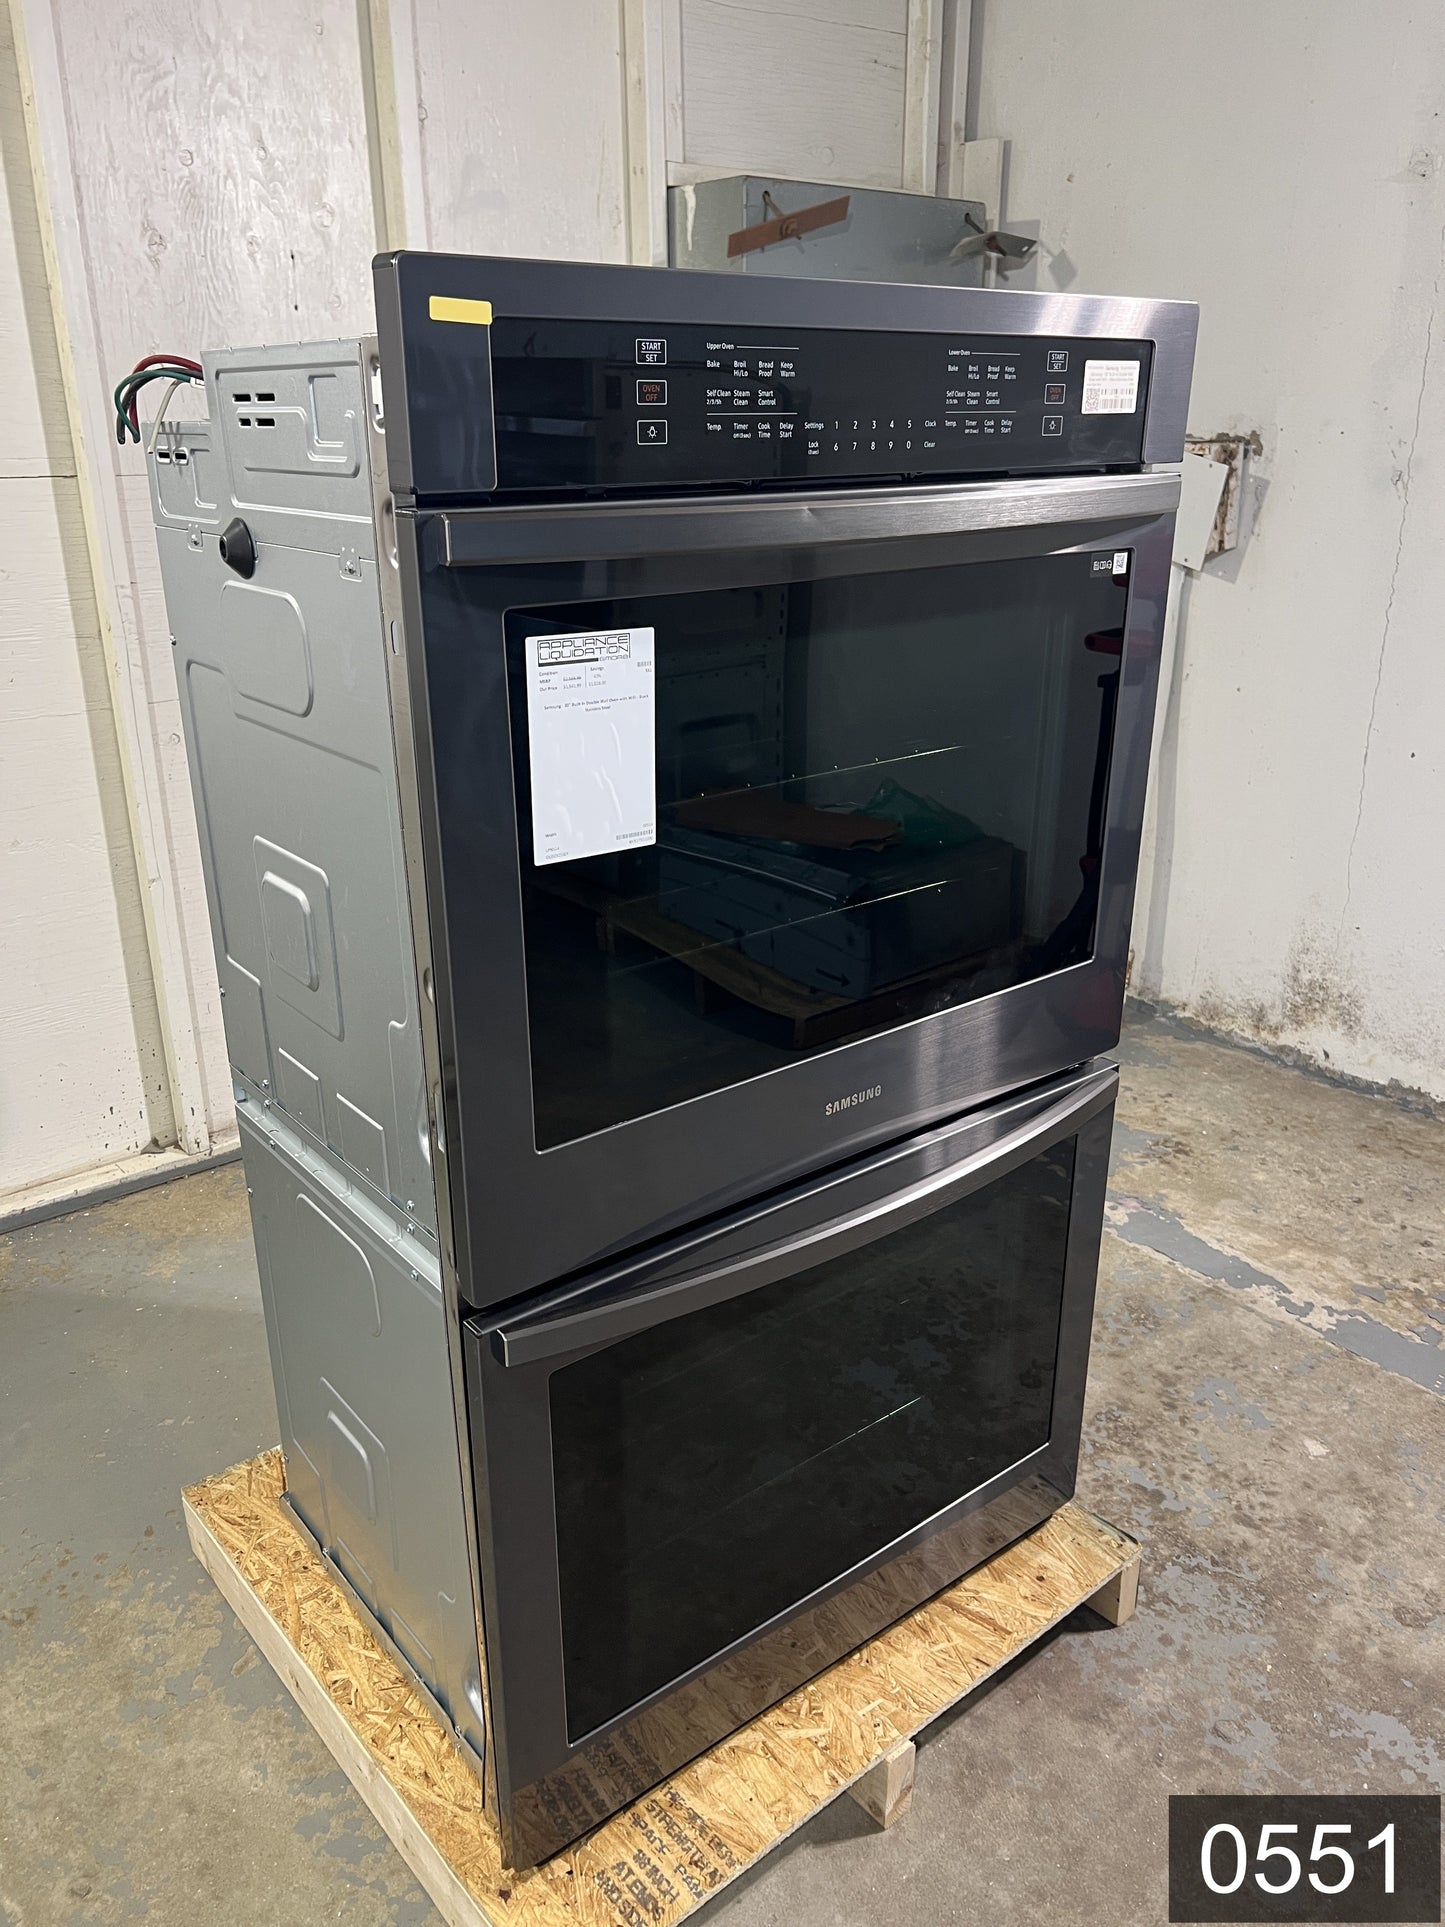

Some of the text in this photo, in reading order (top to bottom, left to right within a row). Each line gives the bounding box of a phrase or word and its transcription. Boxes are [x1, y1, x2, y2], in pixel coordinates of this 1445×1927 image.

[642, 342, 661, 350] START
[706, 342, 721, 350] Upper
[646, 354, 658, 362] SET
[706, 360, 720, 368] Bake
[780, 362, 794, 370] Keep
[706, 423, 722, 431] Temp
[758, 422, 770, 430] Cook
[779, 422, 794, 430] Delay
[804, 422, 824, 430] Settings
[835, 421, 839, 430] 1
[853, 421, 858, 429] 2
[872, 420, 876, 429] 3
[889, 420, 894, 428] 4
[907, 420, 912, 428] 5
[834, 442, 838, 451] 6
[853, 442, 857, 450] 7
[870, 442, 876, 450] 8
[889, 441, 894, 449] 9
[906, 440, 911, 449] 0
[539, 635, 629, 650] APPLIANCE
[539, 645, 629, 660] LIQUIDATION
[825, 1084, 882, 1116] SAMSUNG
[611, 1861, 636, 1882] AT
